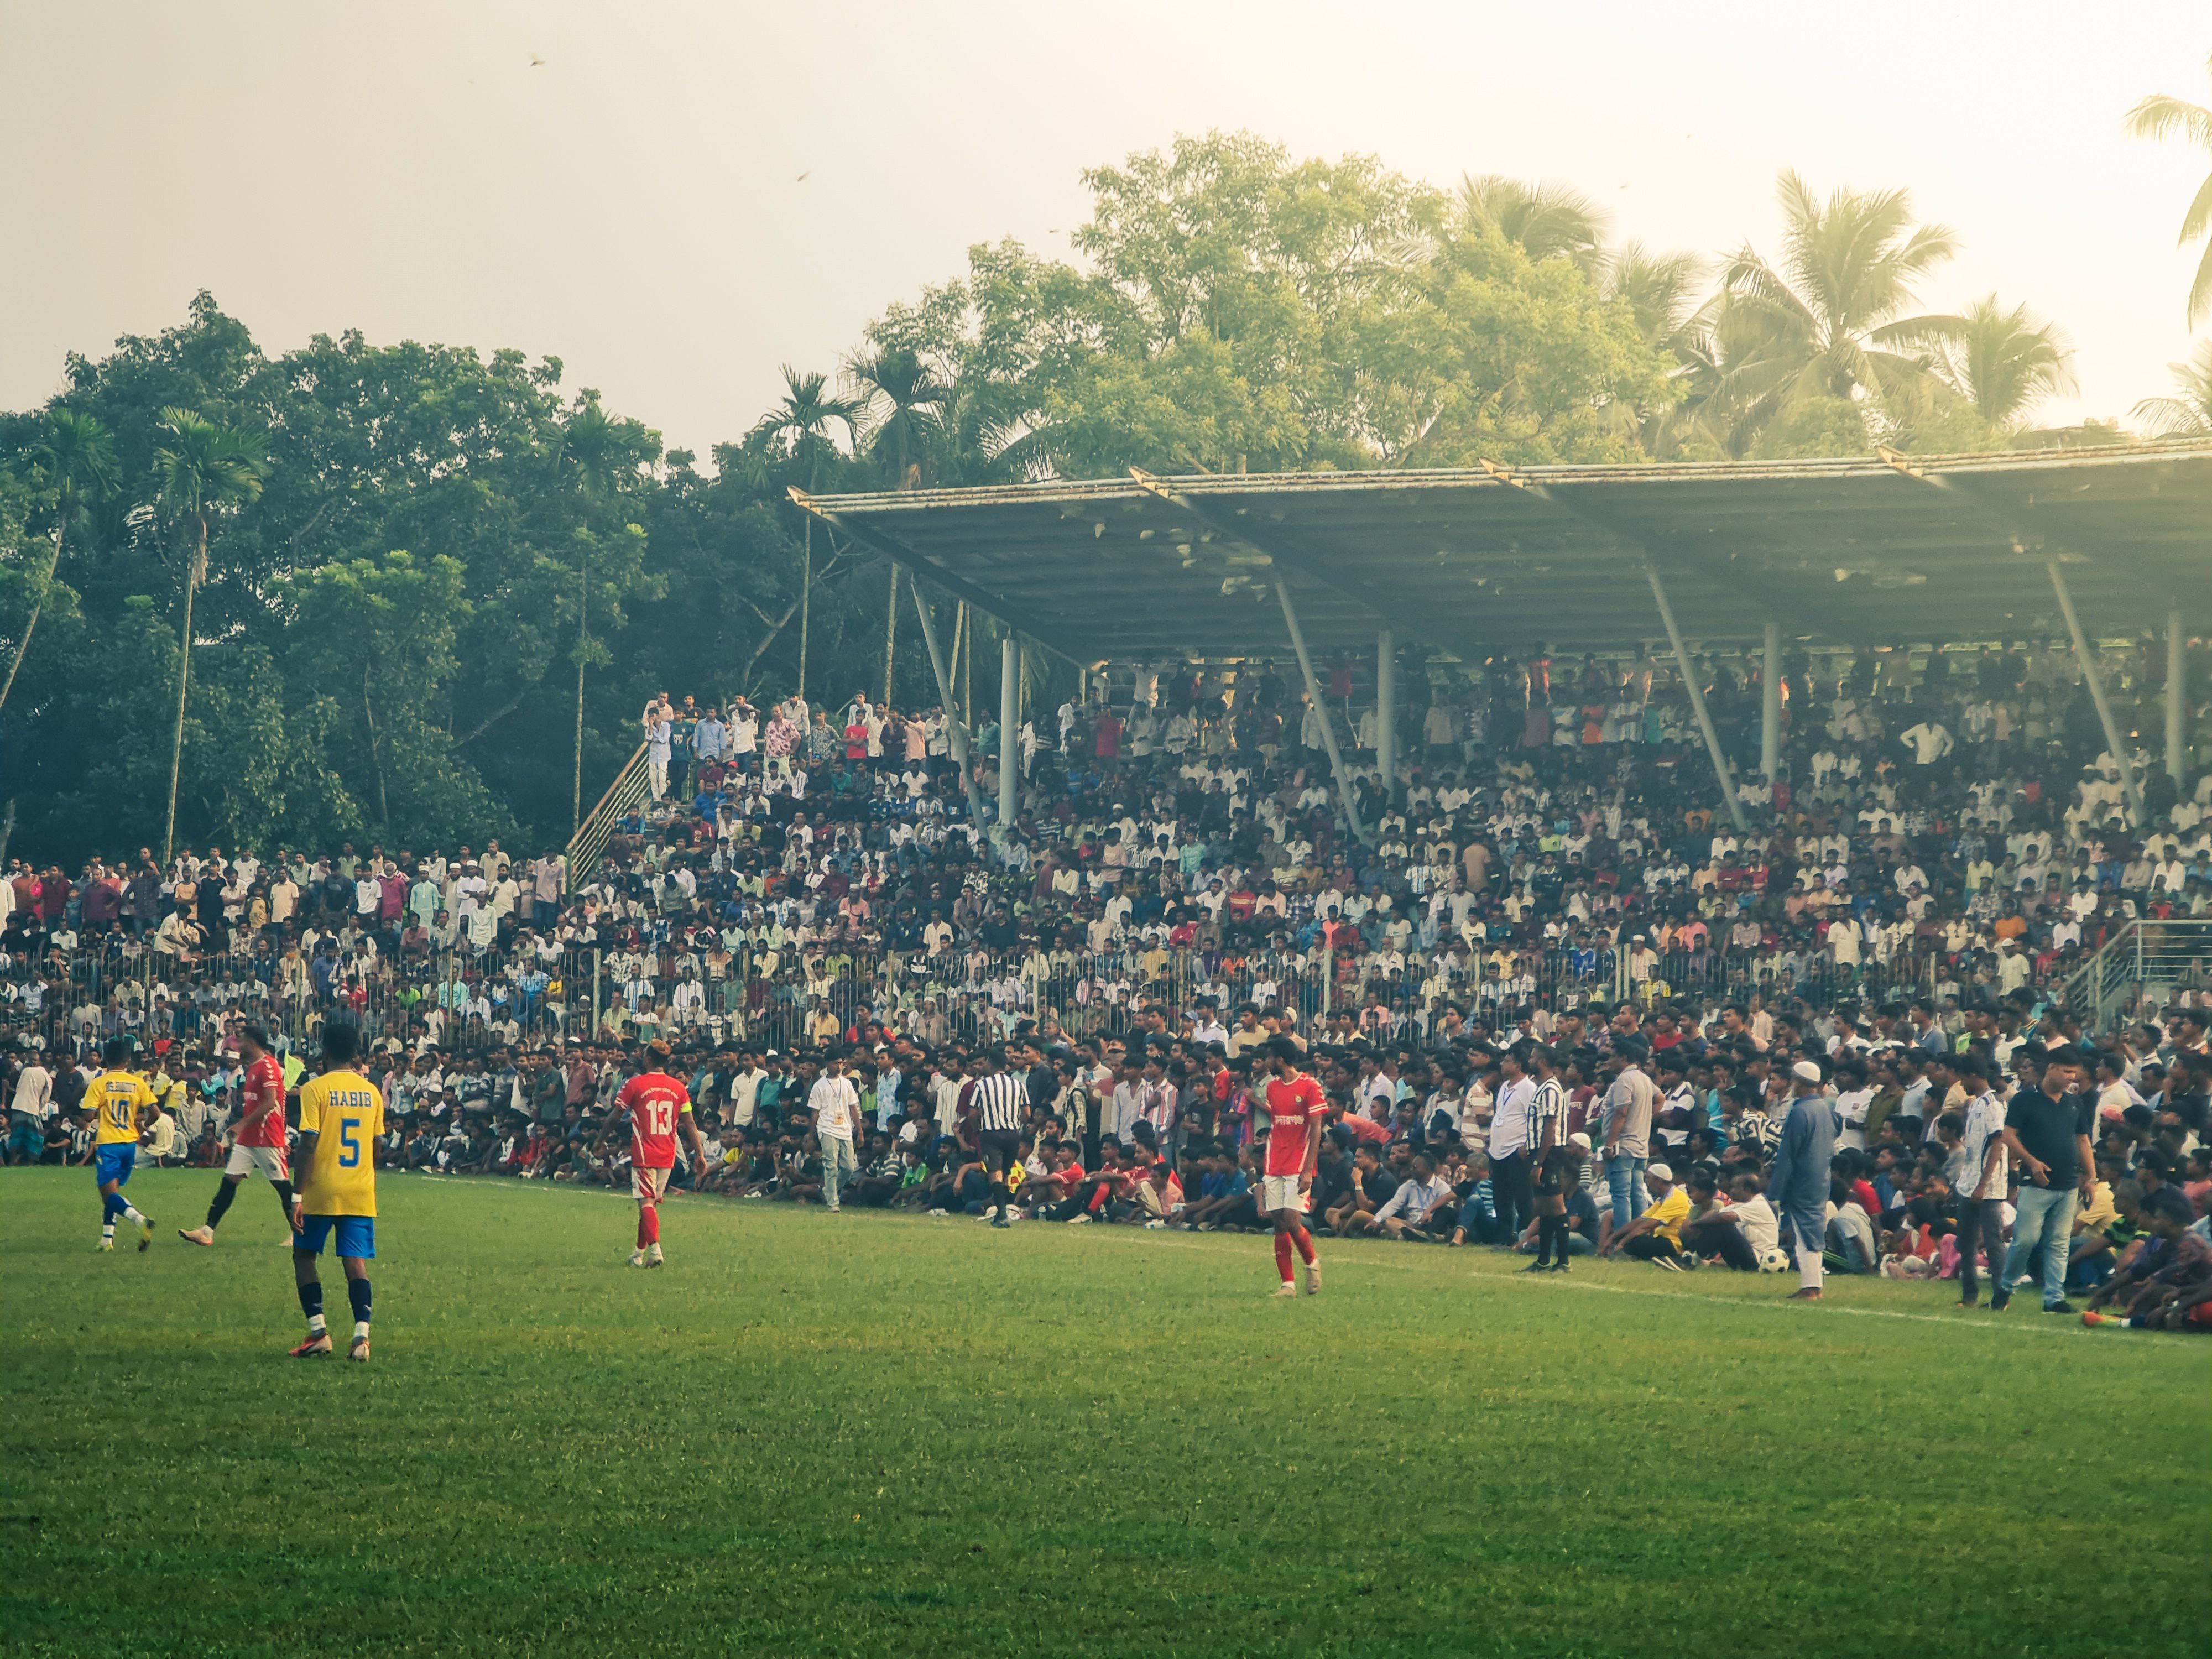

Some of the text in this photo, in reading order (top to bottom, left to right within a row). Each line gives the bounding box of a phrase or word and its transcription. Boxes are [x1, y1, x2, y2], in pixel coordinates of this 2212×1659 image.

[111, 1099, 129, 1130] 10
[330, 1091, 371, 1107] HABIB
[646, 1100, 673, 1135] 13
[339, 1118, 360, 1167] 5
